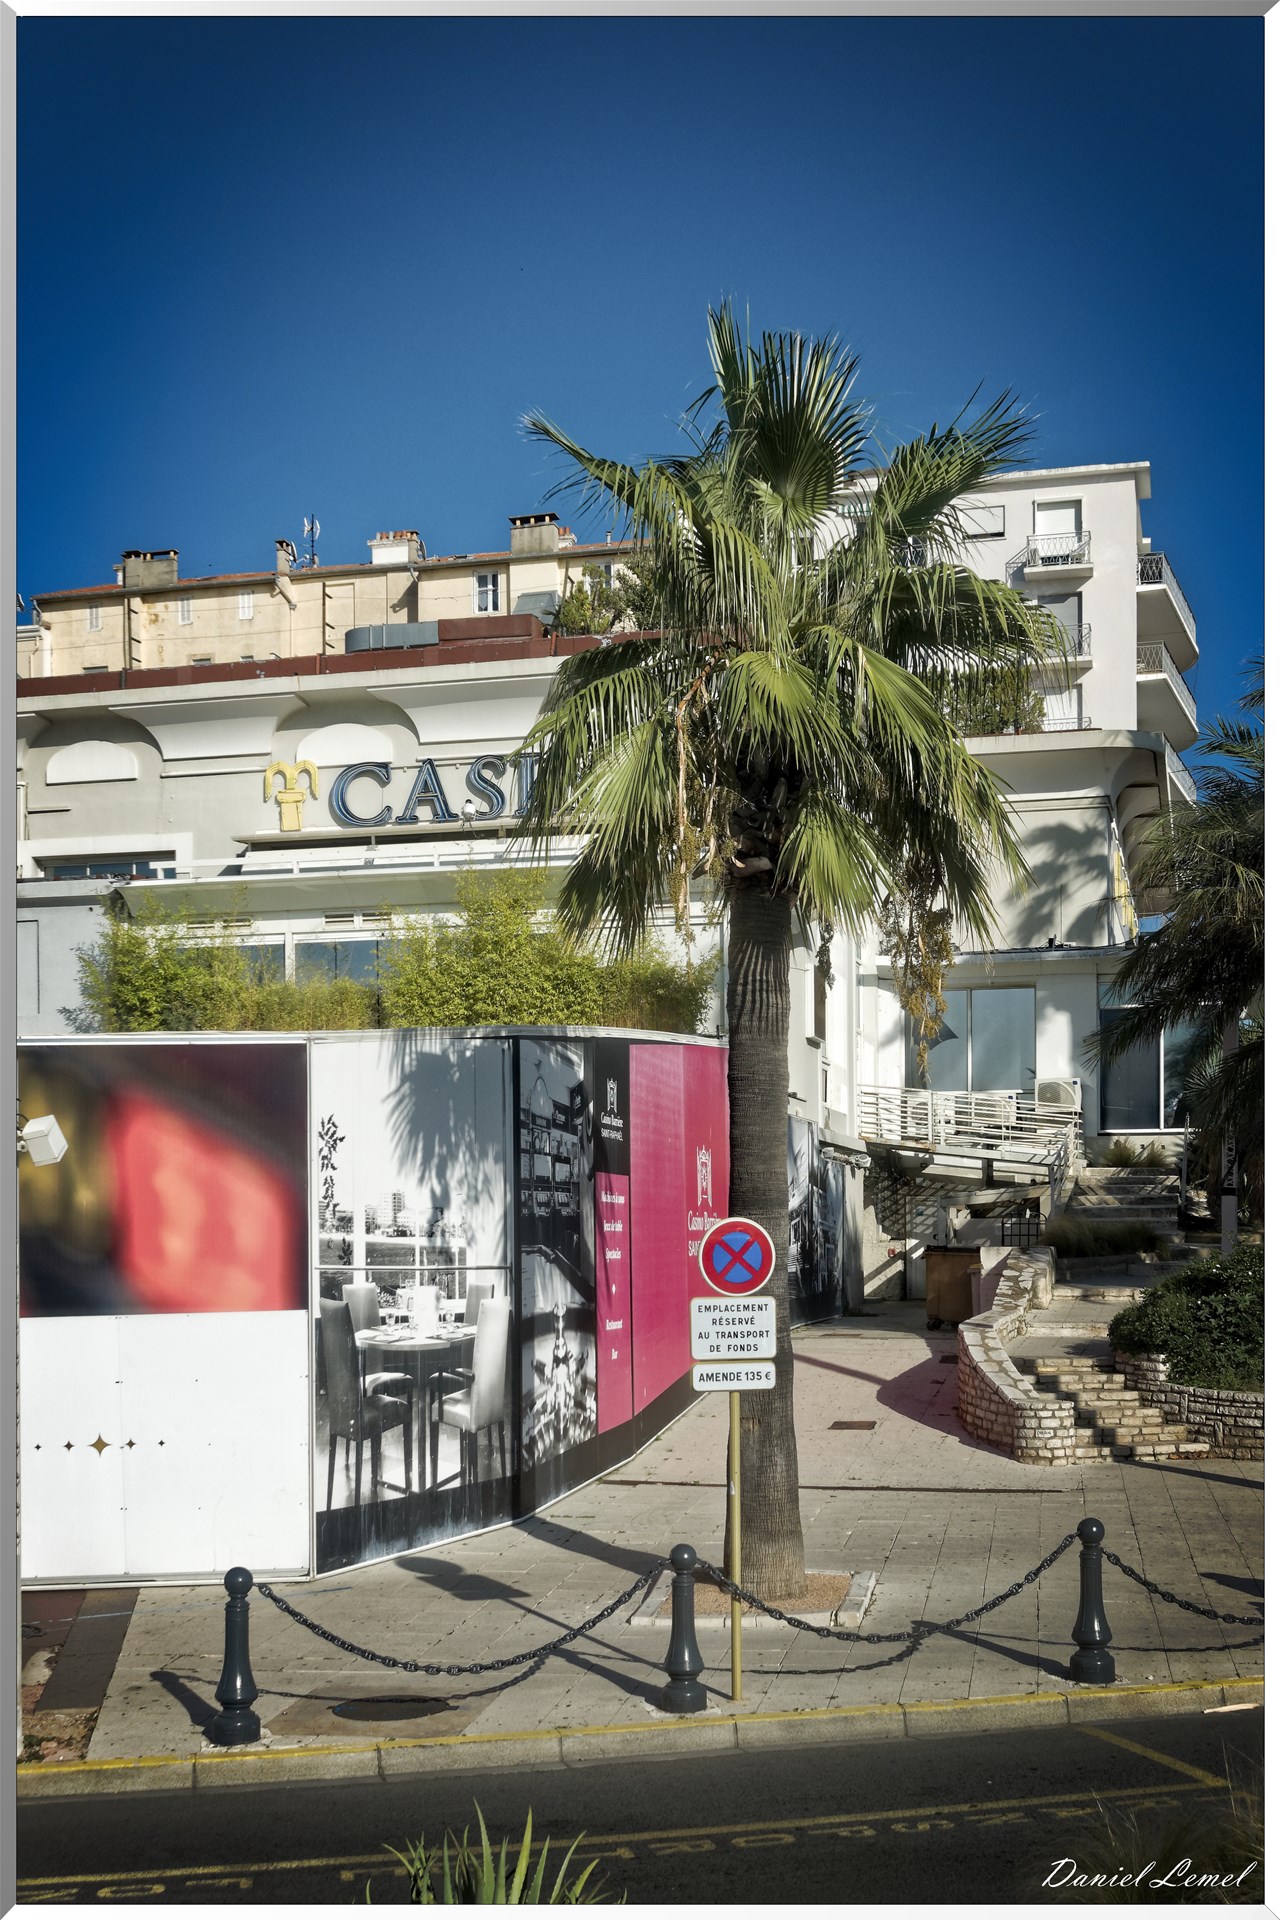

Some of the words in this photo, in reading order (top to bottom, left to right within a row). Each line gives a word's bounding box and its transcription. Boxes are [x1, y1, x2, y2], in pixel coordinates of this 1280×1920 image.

[687, 1210, 704, 1231] Casino
[697, 1303, 769, 1313] EMPLACEMENT
[711, 1315, 756, 1326] RÉSERVÉ
[697, 1331, 710, 1340] AU
[715, 1330, 770, 1339] TRANSPORT
[709, 1344, 722, 1353] DE
[727, 1343, 759, 1352] FONDS
[698, 1371, 743, 1382] AMENDE
[744, 1371, 763, 1381] 135
[764, 1371, 771, 1380] €
